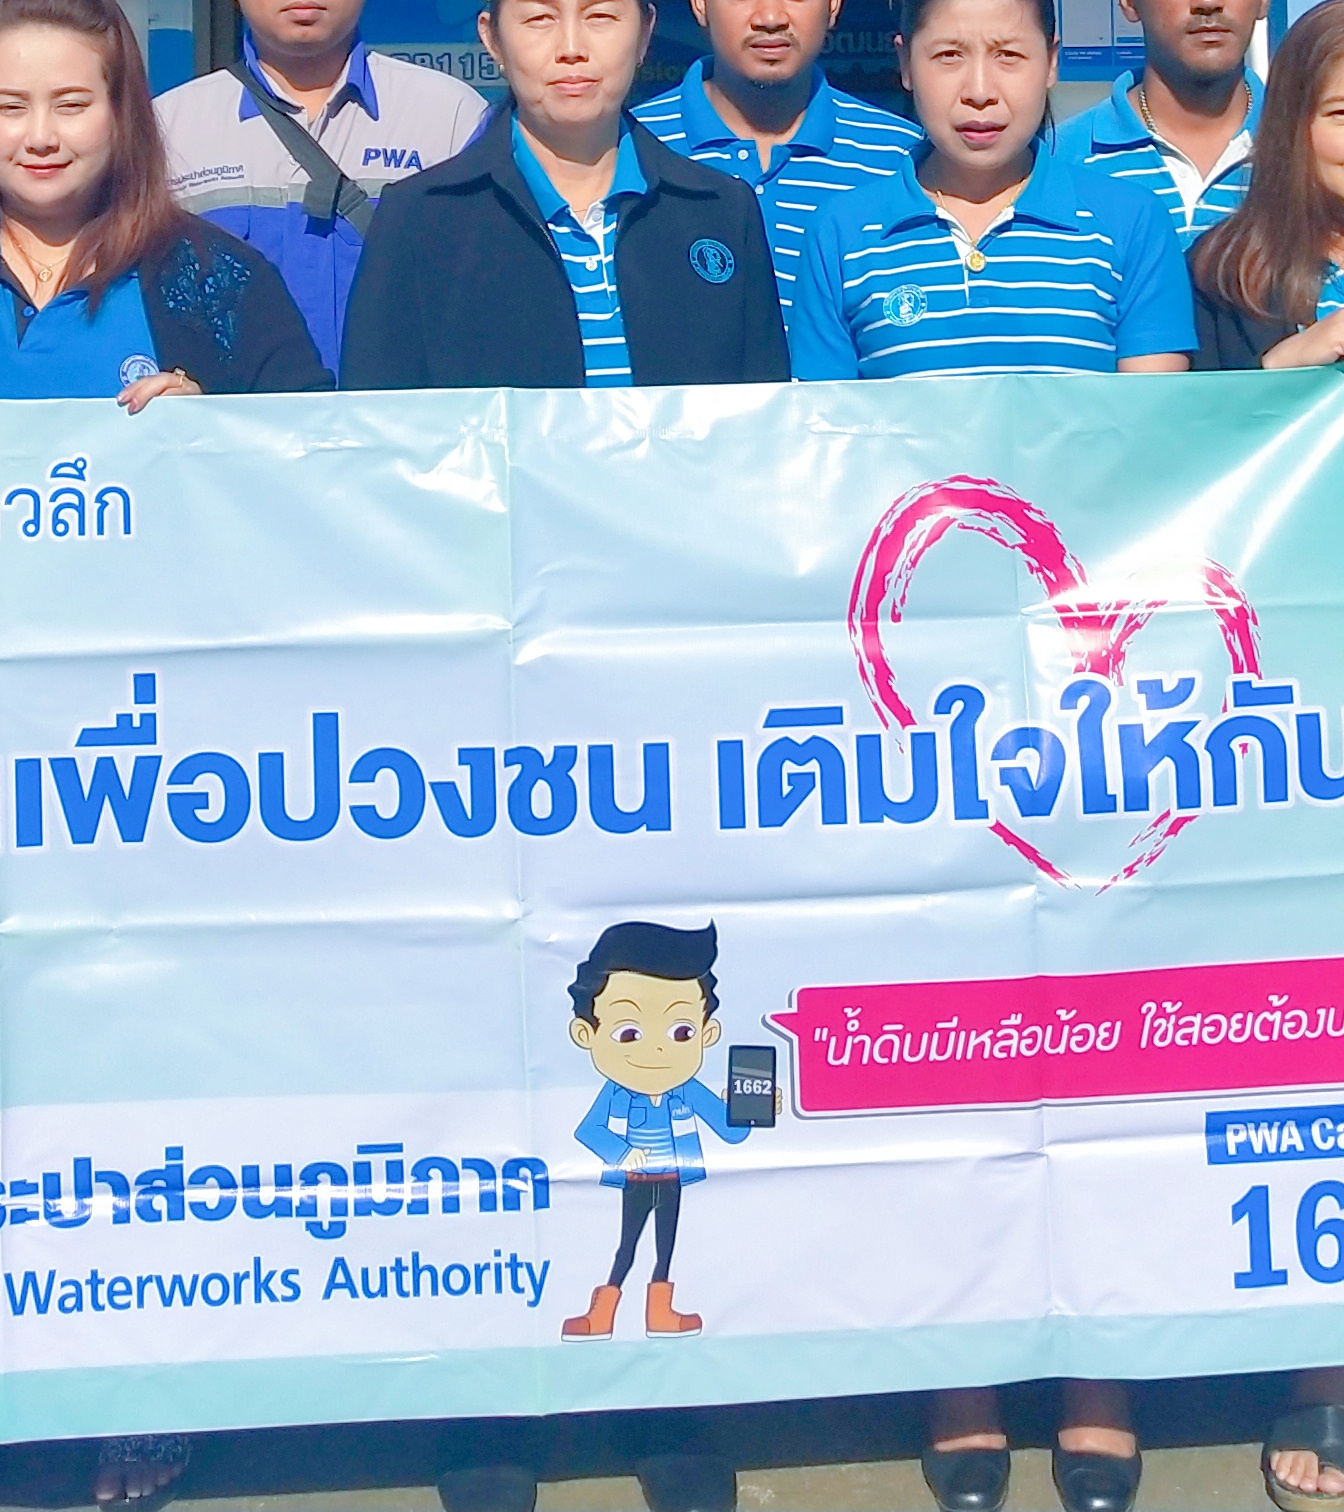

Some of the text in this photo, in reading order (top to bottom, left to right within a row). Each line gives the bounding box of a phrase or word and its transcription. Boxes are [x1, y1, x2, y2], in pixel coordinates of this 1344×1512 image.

[362, 147, 423, 172] PWA
[811, 1005, 1123, 1070] "น้ำดิบมีเหลือน้อย
[733, 1079, 773, 1095] 1662
[1226, 1120, 1304, 1156] PWA
[5, 1258, 301, 1316] Waterworks
[322, 1251, 551, 1307] Authority
